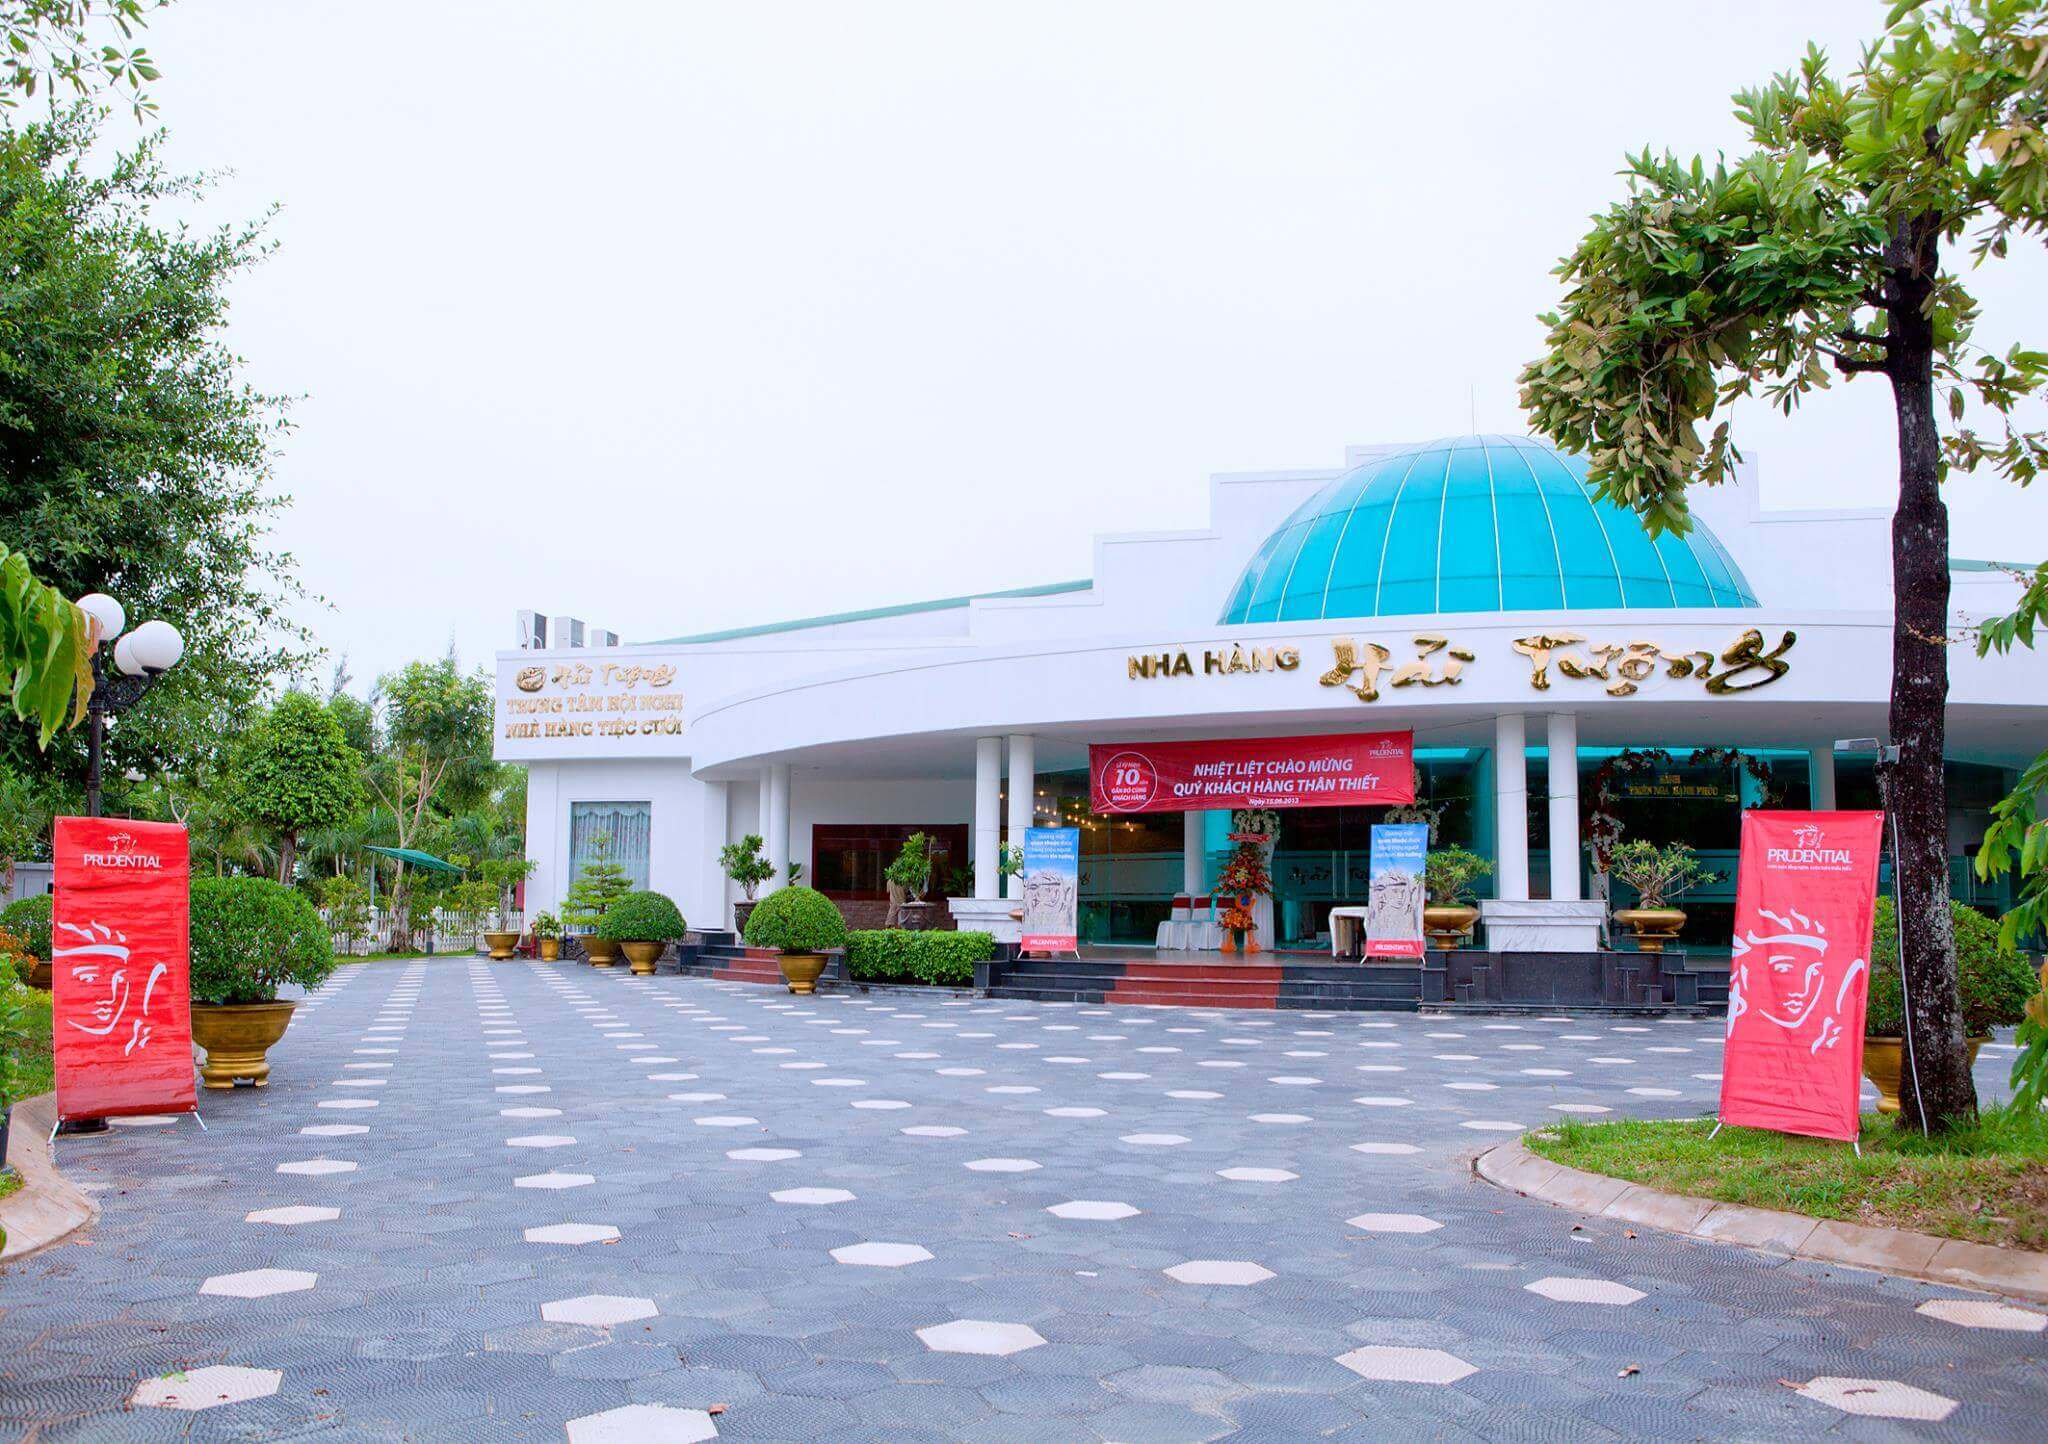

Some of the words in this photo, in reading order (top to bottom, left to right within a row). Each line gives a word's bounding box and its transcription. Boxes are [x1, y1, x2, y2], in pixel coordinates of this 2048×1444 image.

[1128, 643, 1194, 680] NHÀ
[1204, 641, 1300, 675] HÀNG
[506, 697, 563, 714] TRUNG
[567, 693, 604, 713] TÂM
[606, 693, 637, 714] HỘI
[639, 693, 684, 713] NGHỊ
[505, 718, 541, 739] NHÀ
[544, 718, 594, 738] HÀNG
[597, 717, 638, 739] TIỆC
[640, 714, 683, 736] CƯỚI
[1115, 768, 1140, 786] 10
[1193, 761, 1235, 778] NHIỆT
[1235, 760, 1265, 777] LIỆT
[1266, 758, 1306, 774] CHÀO
[1308, 757, 1353, 772] MỪNG
[1173, 781, 1203, 796] QUÝ
[1204, 779, 1252, 795] KHÁCH
[1253, 778, 1295, 793] HÀNG
[1297, 776, 1336, 792] THÂN
[1339, 773, 1379, 791] THIẾT
[83, 853, 163, 868] PRUDENTIAL
[1767, 848, 1853, 864] PRUDENTIAL
